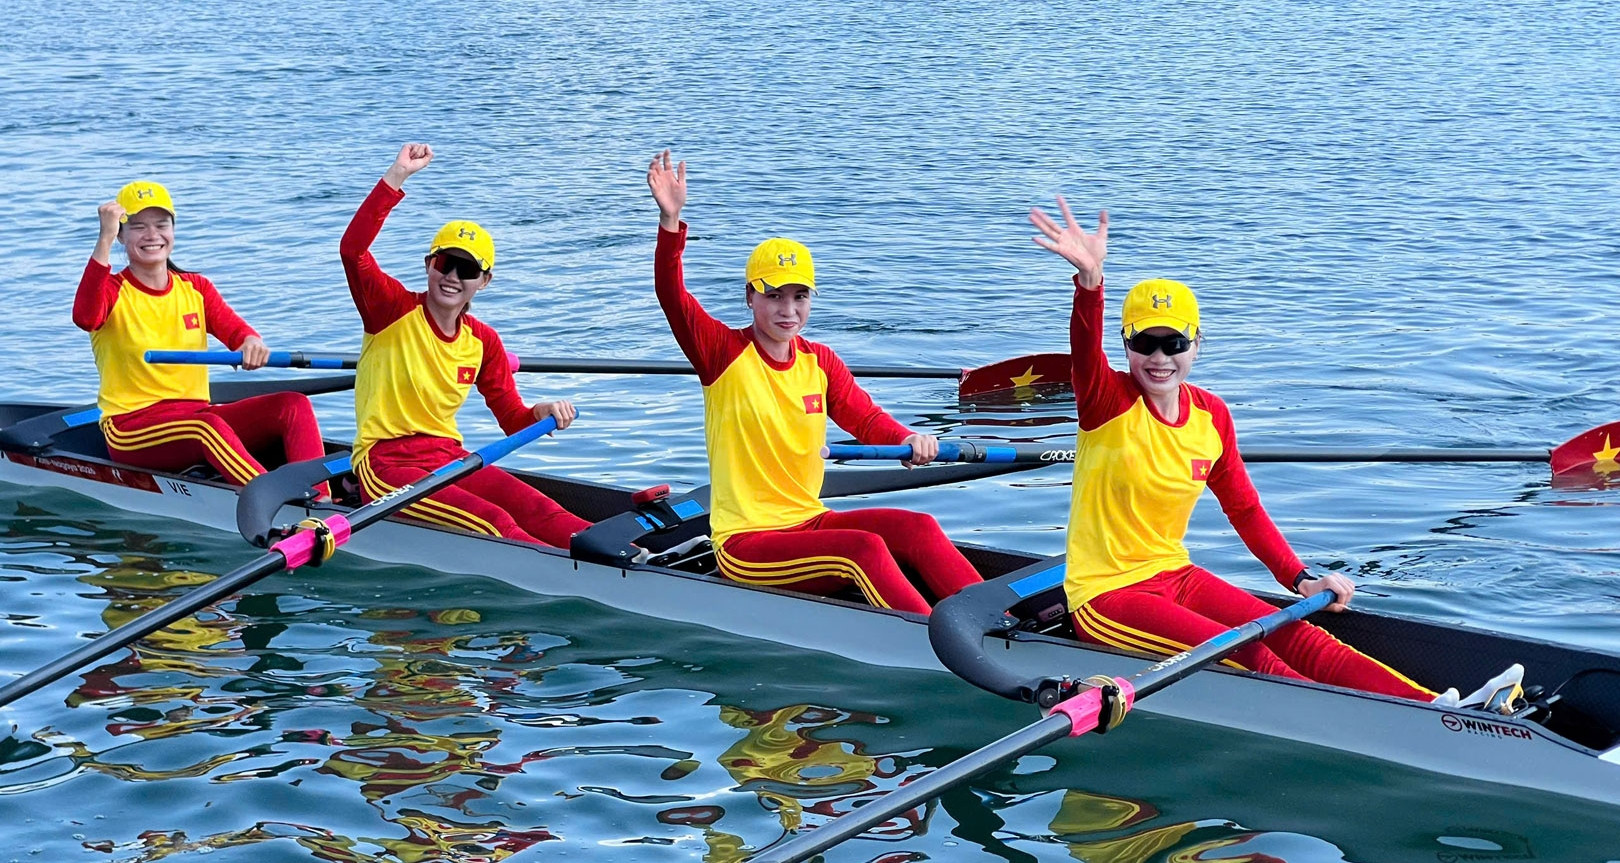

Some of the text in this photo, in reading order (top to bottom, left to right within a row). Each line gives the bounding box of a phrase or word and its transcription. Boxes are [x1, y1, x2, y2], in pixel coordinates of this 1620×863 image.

[1040, 450, 1077, 461] CROKE
[166, 480, 192, 497] VIE
[1461, 718, 1532, 740] WINTECH
[1467, 730, 1503, 740] RACING
